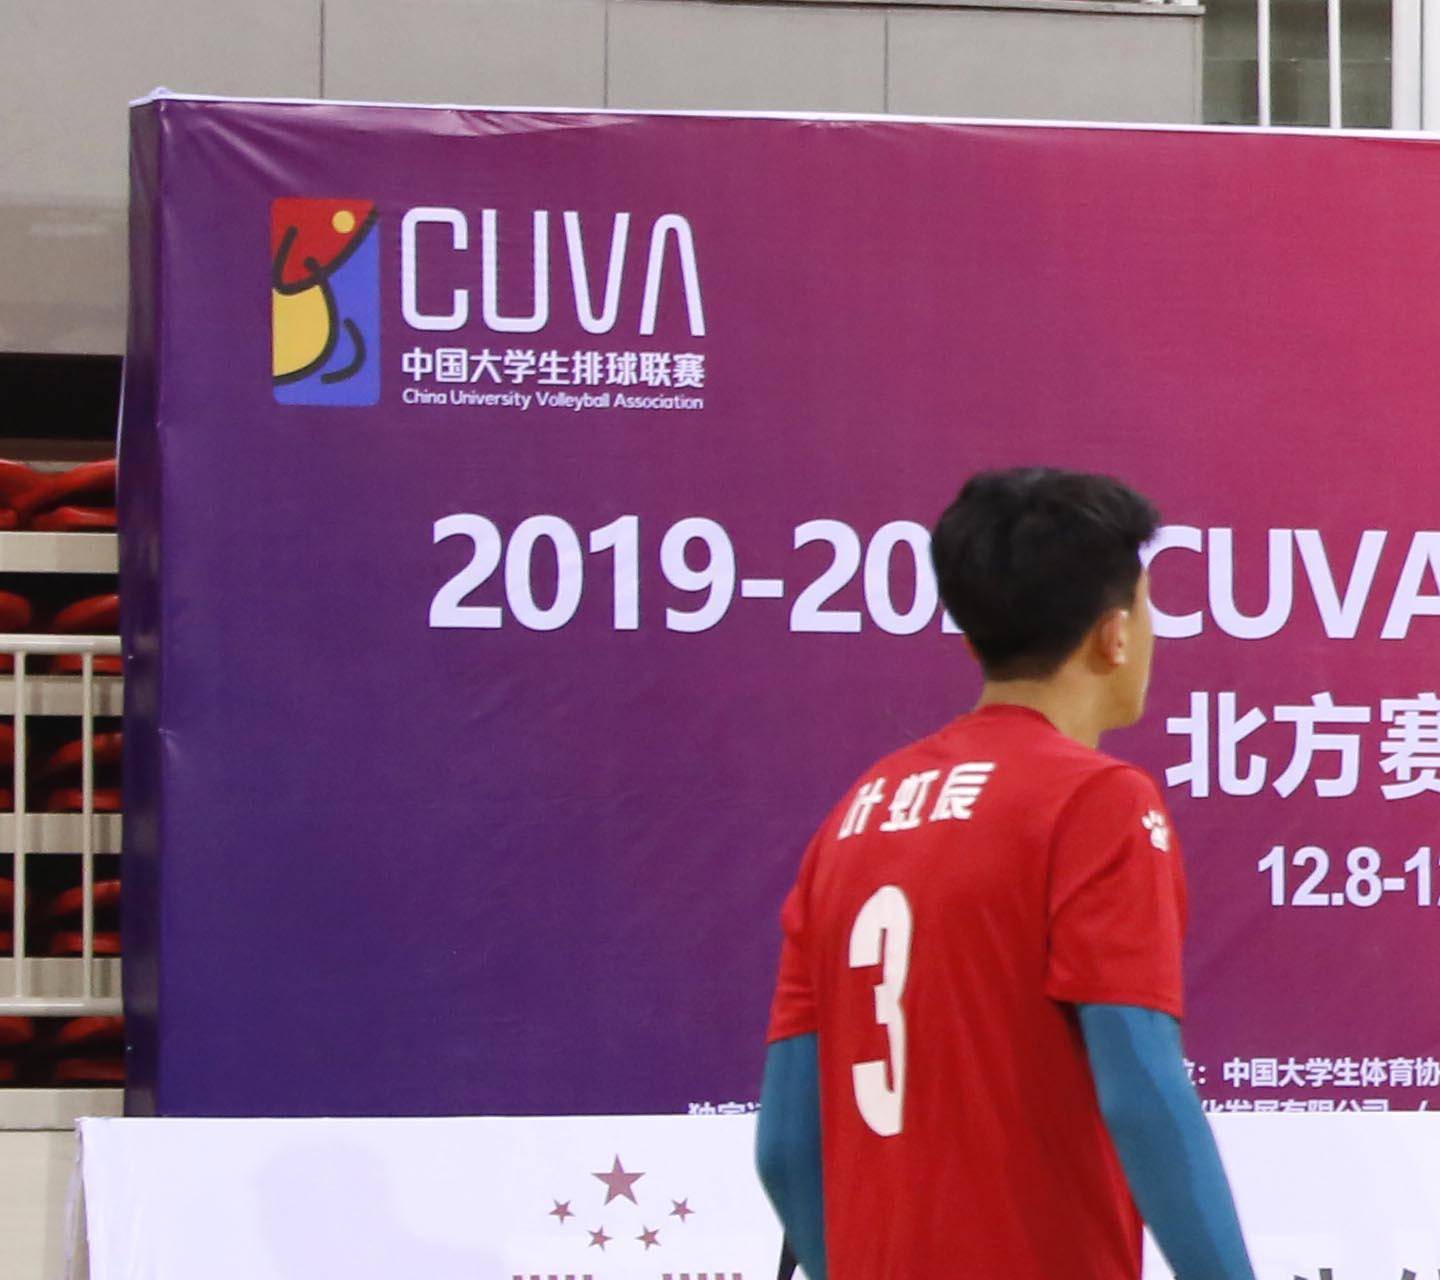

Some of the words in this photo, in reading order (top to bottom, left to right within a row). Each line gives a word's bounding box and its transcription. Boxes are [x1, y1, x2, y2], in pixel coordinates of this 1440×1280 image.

[401, 206, 706, 337] CUVA
[402, 346, 706, 388] 中国大学生排球联赛
[402, 388, 447, 405] China
[451, 389, 531, 411] University
[536, 391, 610, 412] Volleyball
[613, 393, 704, 411] Association
[428, 514, 963, 636] 2019-20
[849, 884, 913, 1137] 3
